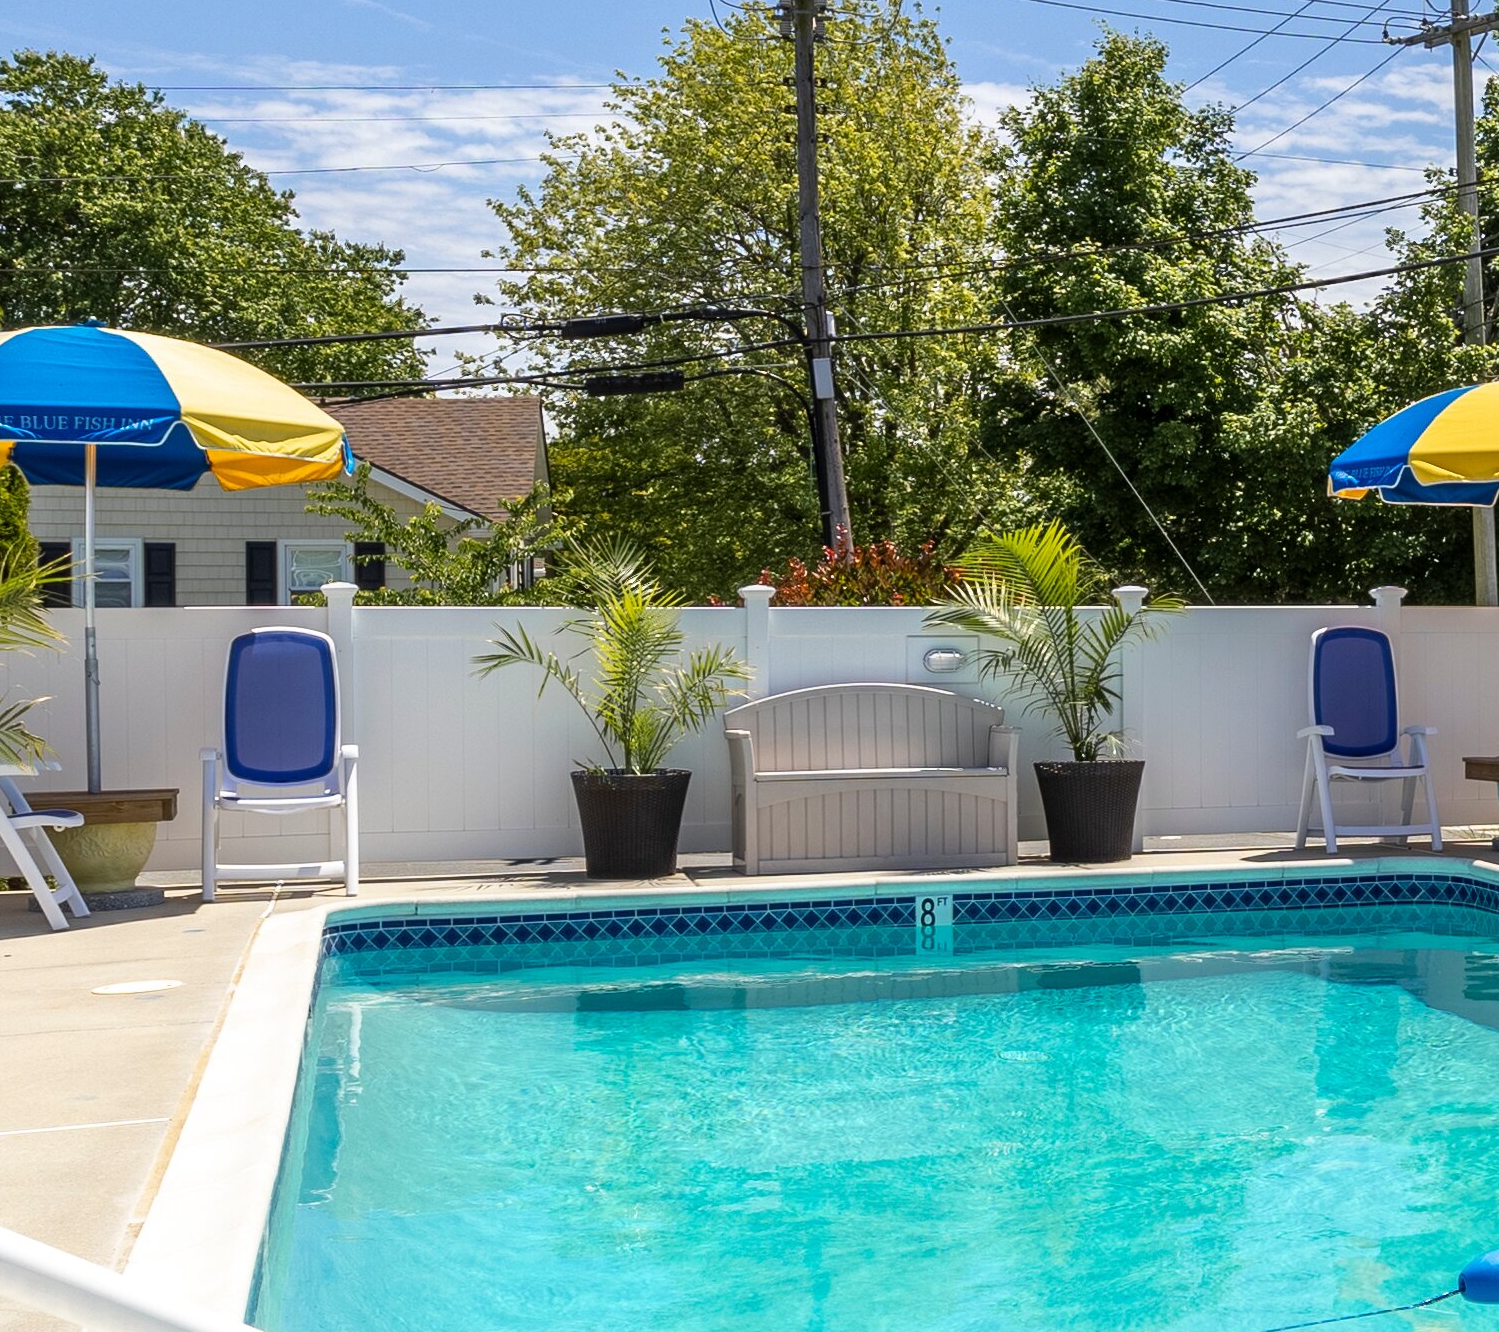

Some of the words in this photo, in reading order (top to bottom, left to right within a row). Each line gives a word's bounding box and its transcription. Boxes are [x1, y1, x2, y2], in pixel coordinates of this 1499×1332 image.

[20, 415, 69, 430] BLUE
[74, 416, 116, 431] FISH
[920, 897, 935, 926] 8
[937, 897, 949, 906] FT
